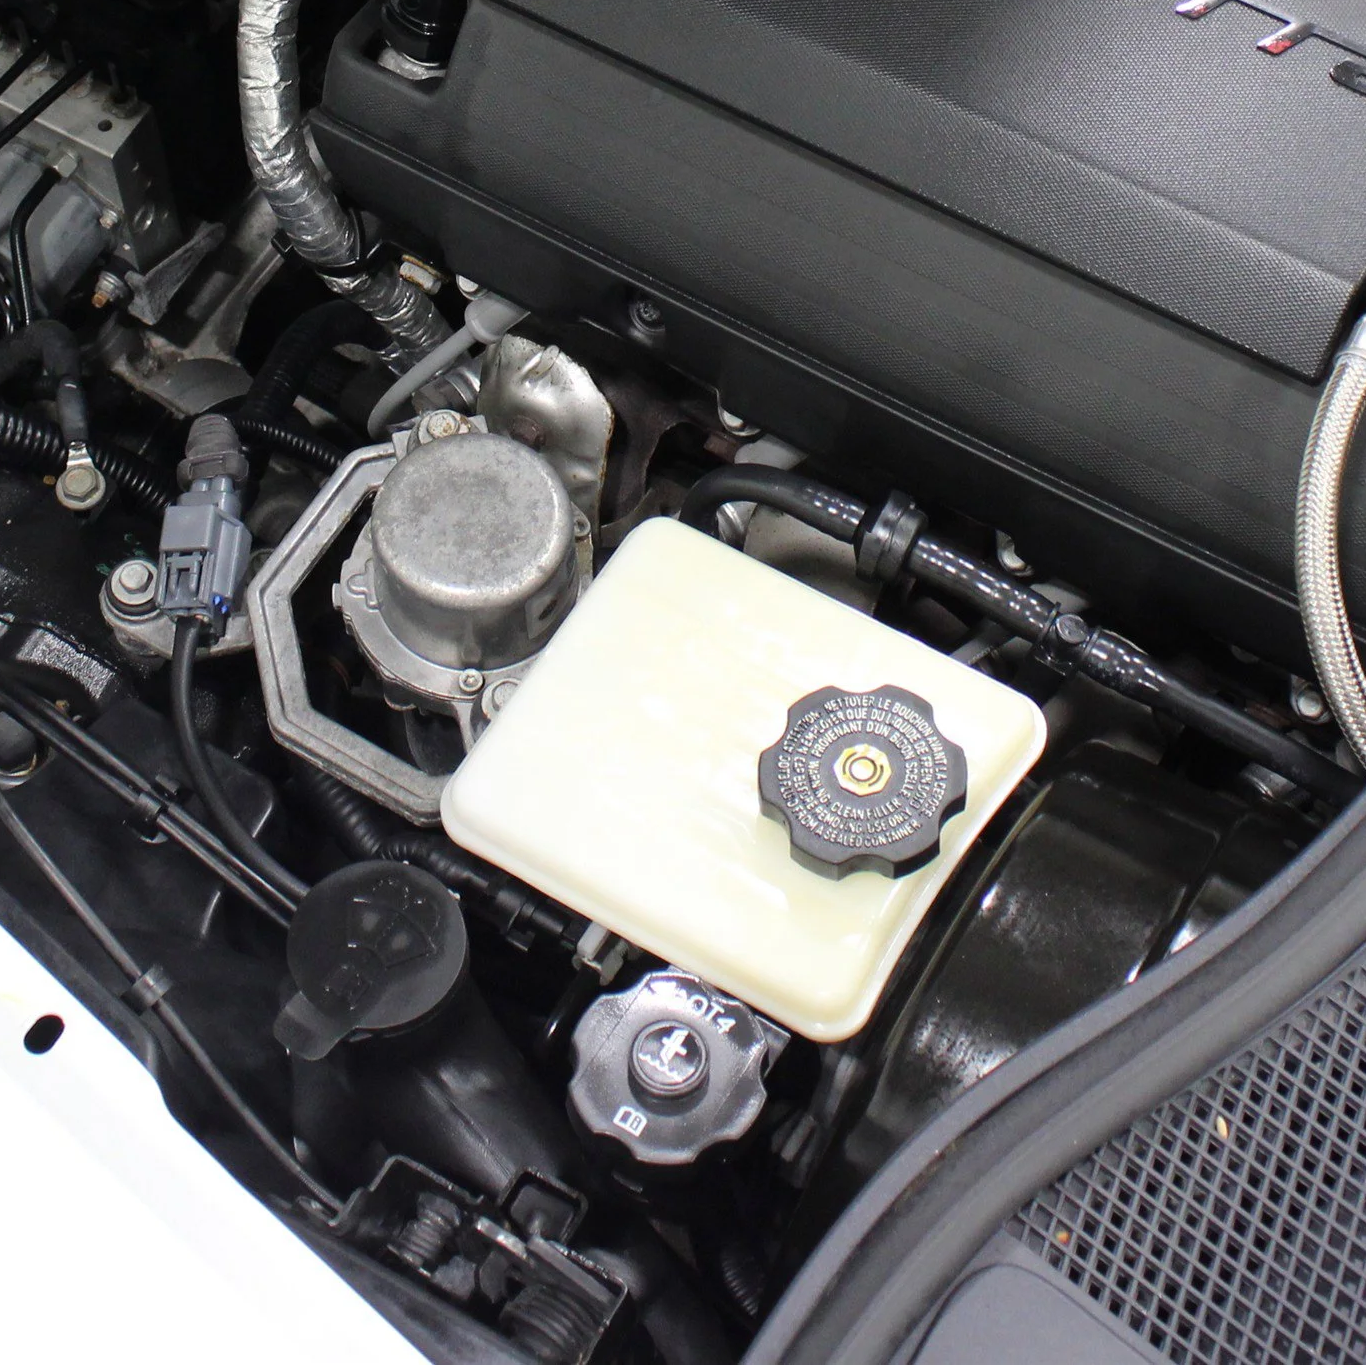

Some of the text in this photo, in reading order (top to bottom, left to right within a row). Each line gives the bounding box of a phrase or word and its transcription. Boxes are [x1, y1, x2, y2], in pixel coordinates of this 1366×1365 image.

[877, 697, 892, 711] LE
[891, 701, 934, 737] BOUCHON
[810, 720, 863, 758] PROVENANT
[865, 720, 892, 738] D'UN
[889, 731, 916, 760] BIDON
[845, 707, 868, 720] QUE
[870, 708, 886, 722] DU
[913, 740, 930, 755] DE
[926, 735, 948, 765] AVANT
[935, 766, 948, 780] LA
[830, 801, 865, 820] CLEAN
[865, 797, 903, 820] FILLER
[887, 806, 913, 827] ONLY
[792, 804, 820, 831] FROM
[815, 824, 825, 836] A
[823, 827, 864, 848] SEALED
